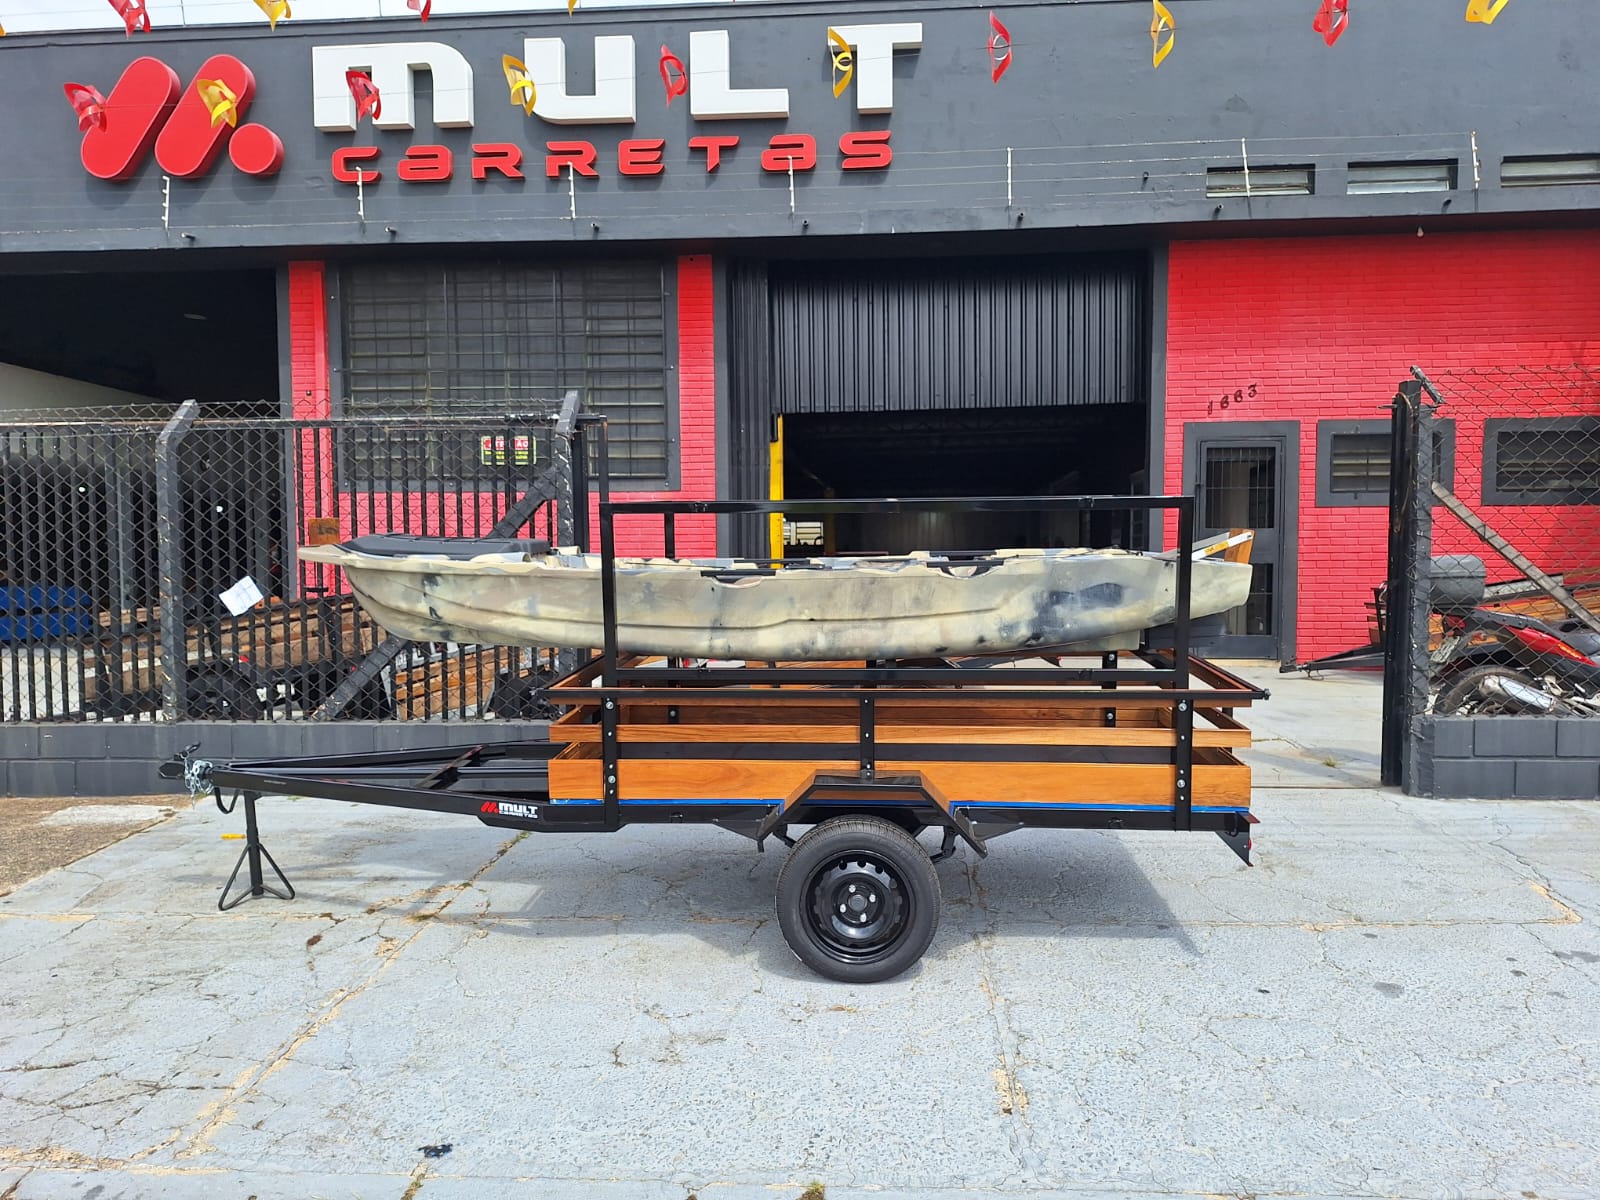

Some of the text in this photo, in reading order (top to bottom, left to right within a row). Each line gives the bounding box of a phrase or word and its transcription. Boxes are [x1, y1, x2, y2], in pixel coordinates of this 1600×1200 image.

[312, 22, 923, 132] MULT
[331, 130, 893, 183] CARRETAS
[498, 802, 539, 815] MULT
